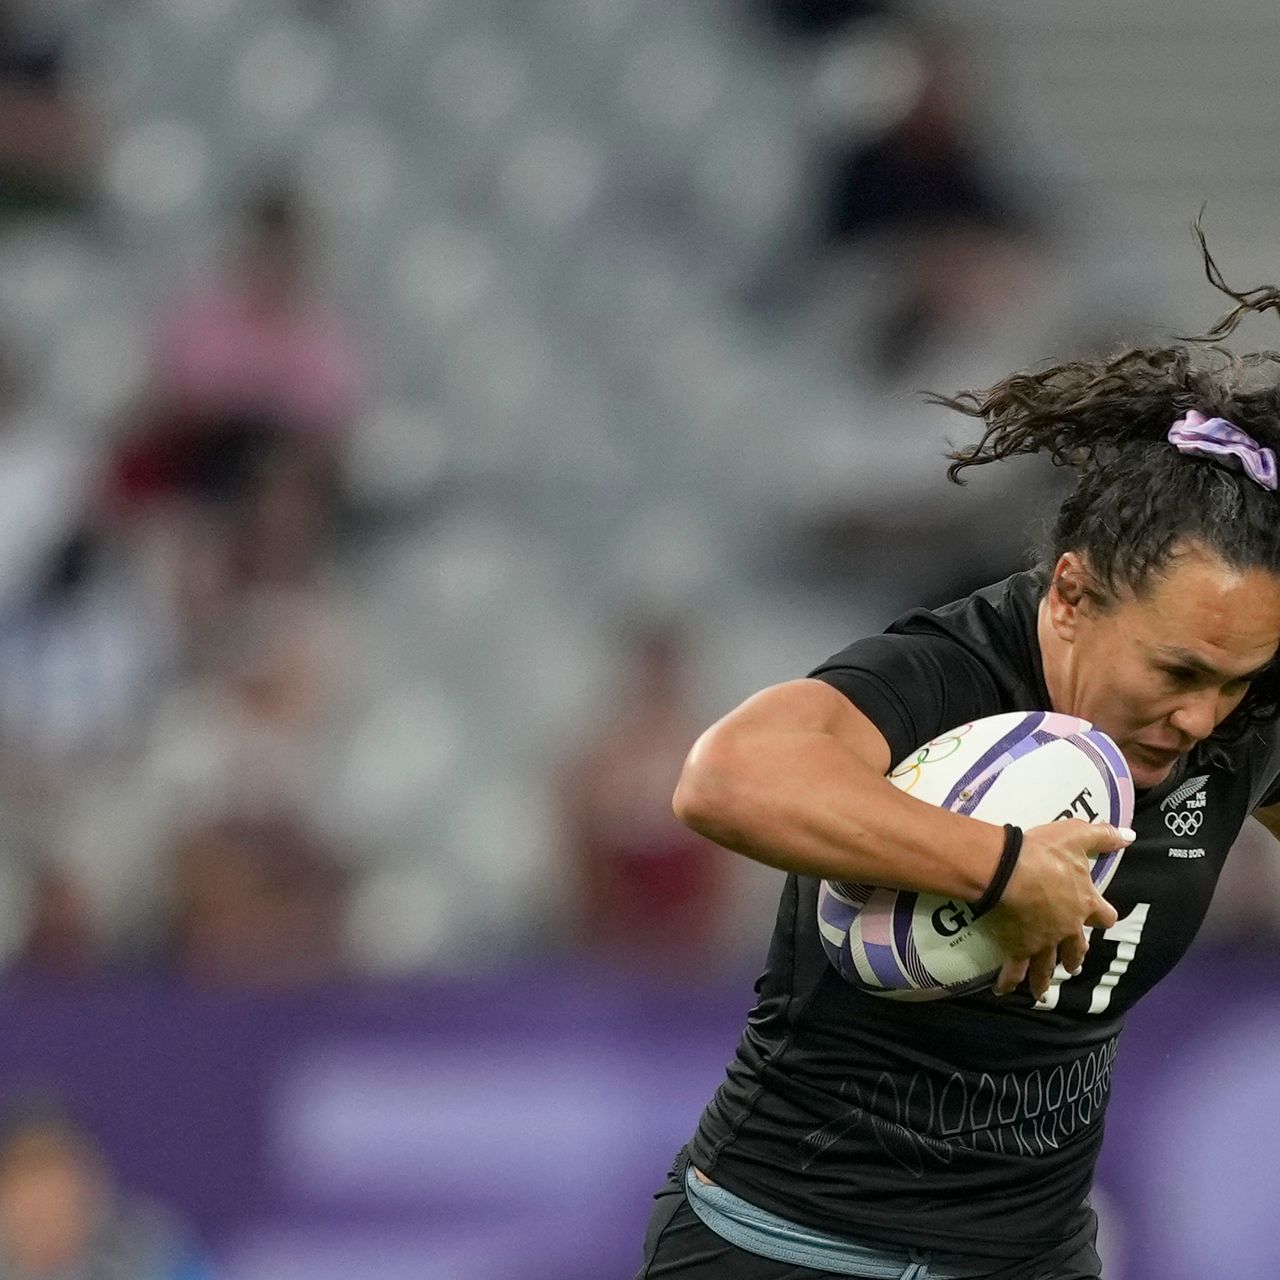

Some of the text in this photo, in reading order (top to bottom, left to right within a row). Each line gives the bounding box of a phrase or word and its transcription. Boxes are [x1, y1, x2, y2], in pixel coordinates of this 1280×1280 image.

[1195, 790, 1207, 800] NZ
[1185, 799, 1207, 809] TEAM
[1168, 847, 1206, 859] PARIS 2024
